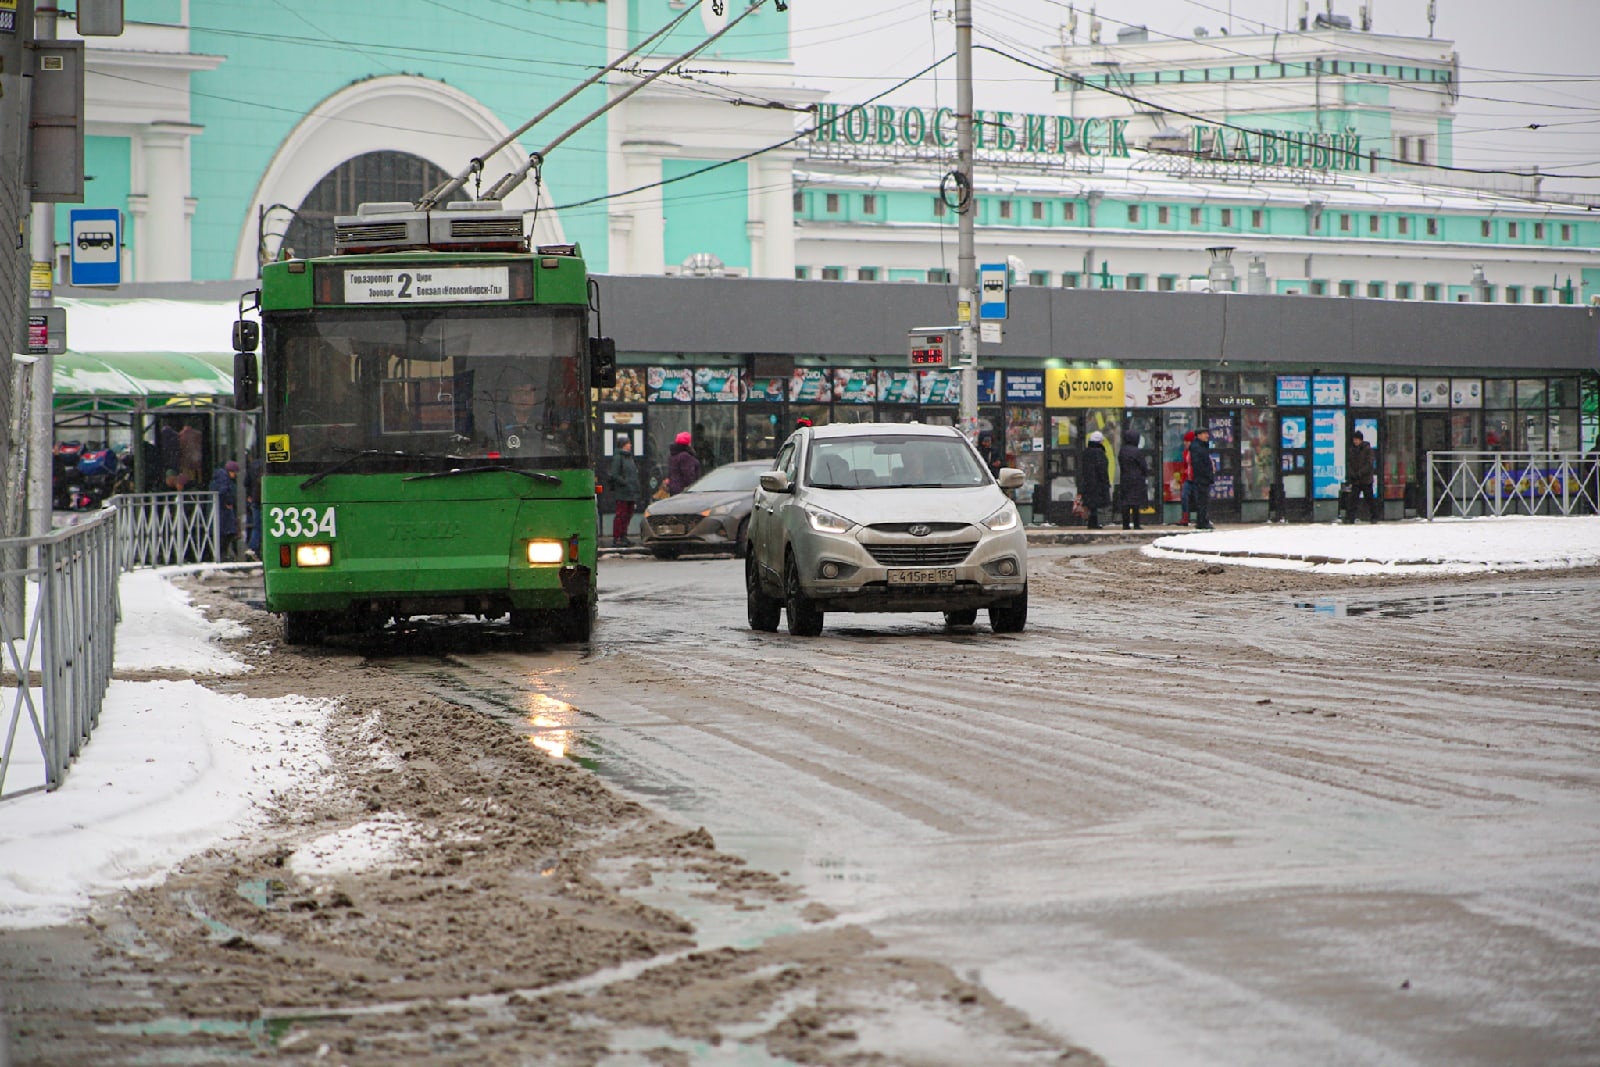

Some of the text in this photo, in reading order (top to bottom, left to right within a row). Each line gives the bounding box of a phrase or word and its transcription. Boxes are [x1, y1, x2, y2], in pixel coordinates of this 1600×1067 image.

[814, 102, 1362, 171] НОВОСИБИРСК ГЛАВНЫЙ
[350, 273, 394, 285] Гор.аэропорт
[416, 272, 433, 283] Цирк
[397, 272, 413, 299] 2
[416, 286, 442, 296] Вокзал
[368, 287, 395, 298] Зоопарк
[1071, 380, 1114, 392] СТОЛОТО
[269, 506, 337, 538] 3334
[937, 570, 953, 580] 154
